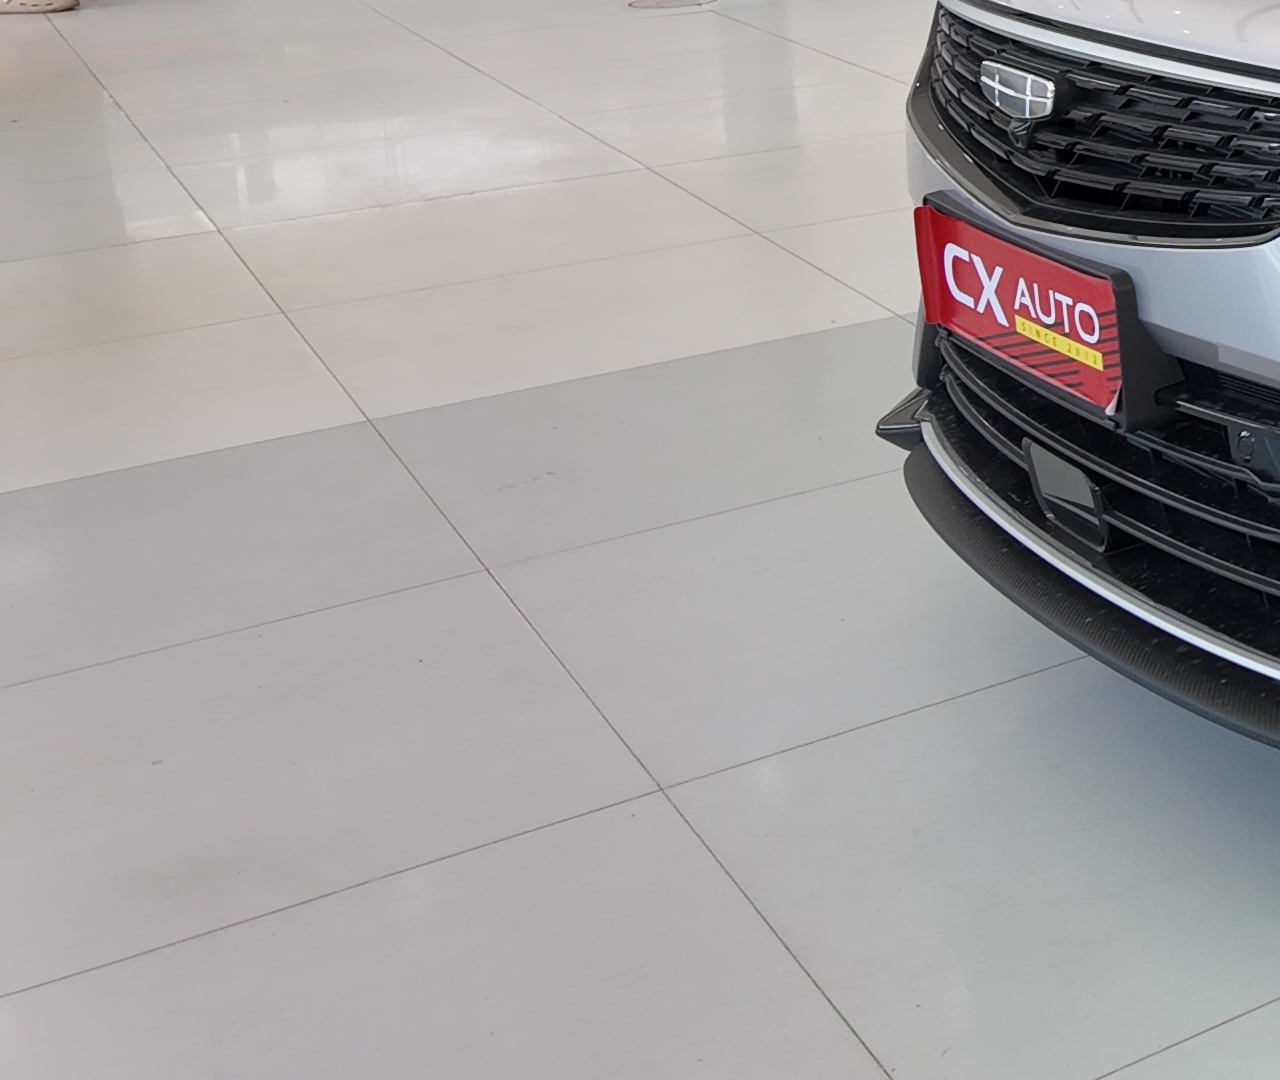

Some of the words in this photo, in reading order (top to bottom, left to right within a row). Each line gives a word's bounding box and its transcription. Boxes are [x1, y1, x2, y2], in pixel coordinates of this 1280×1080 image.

[944, 243, 1009, 327] CX
[1014, 277, 1100, 344] AUTO
[1021, 321, 1058, 347] SINCE
[1067, 341, 1098, 366] 2012
